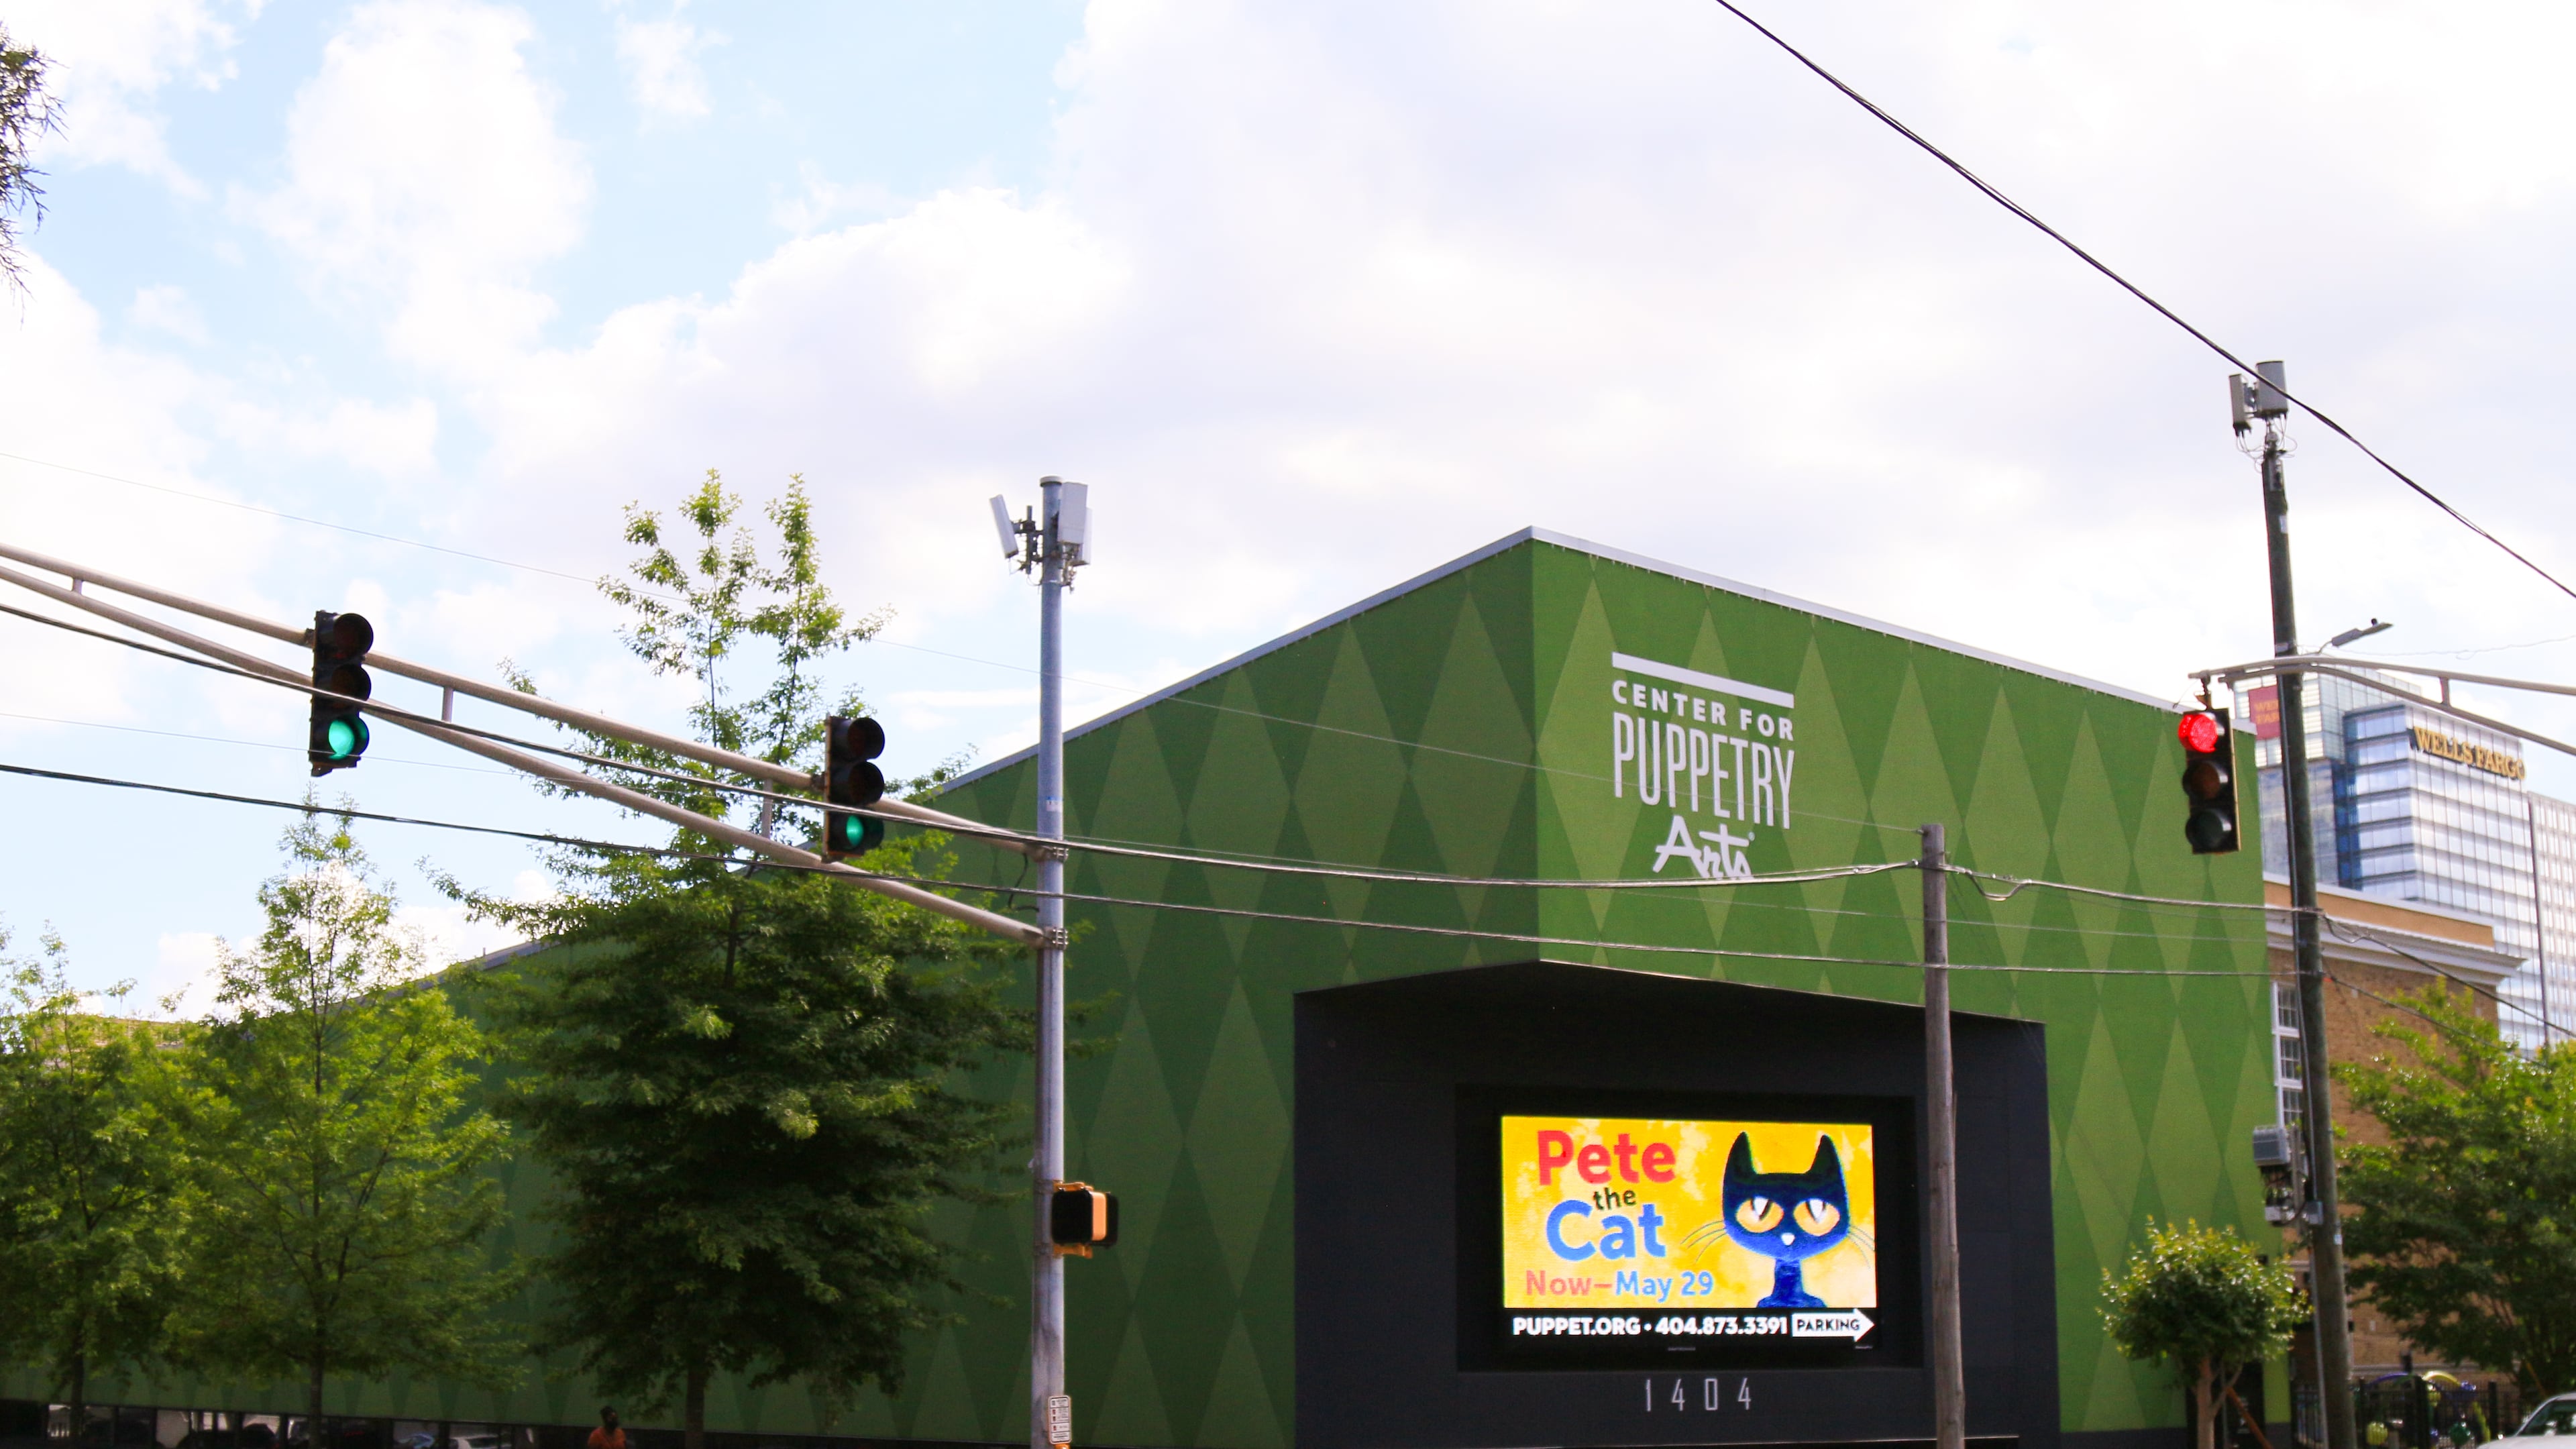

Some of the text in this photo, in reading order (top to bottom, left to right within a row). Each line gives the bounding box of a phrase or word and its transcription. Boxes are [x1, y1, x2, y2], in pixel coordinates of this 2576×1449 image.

[1613, 680, 1794, 741] CENTER FOR
[1613, 711, 1794, 829] PUPPETRY
[2414, 726, 2526, 781] WELLS FARGO
[1652, 814, 1754, 880] Arts
[1538, 1130, 1676, 1185] Pete
[1593, 1187, 1636, 1210] the
[1546, 1199, 1666, 1261] Cat
[1680, 1271, 1714, 1296] 29
[1513, 1316, 1788, 1336] PUPPET.ORG 404.873.3391
[1796, 1318, 1860, 1332] PARKING
[1646, 1377, 1752, 1412] 1404
